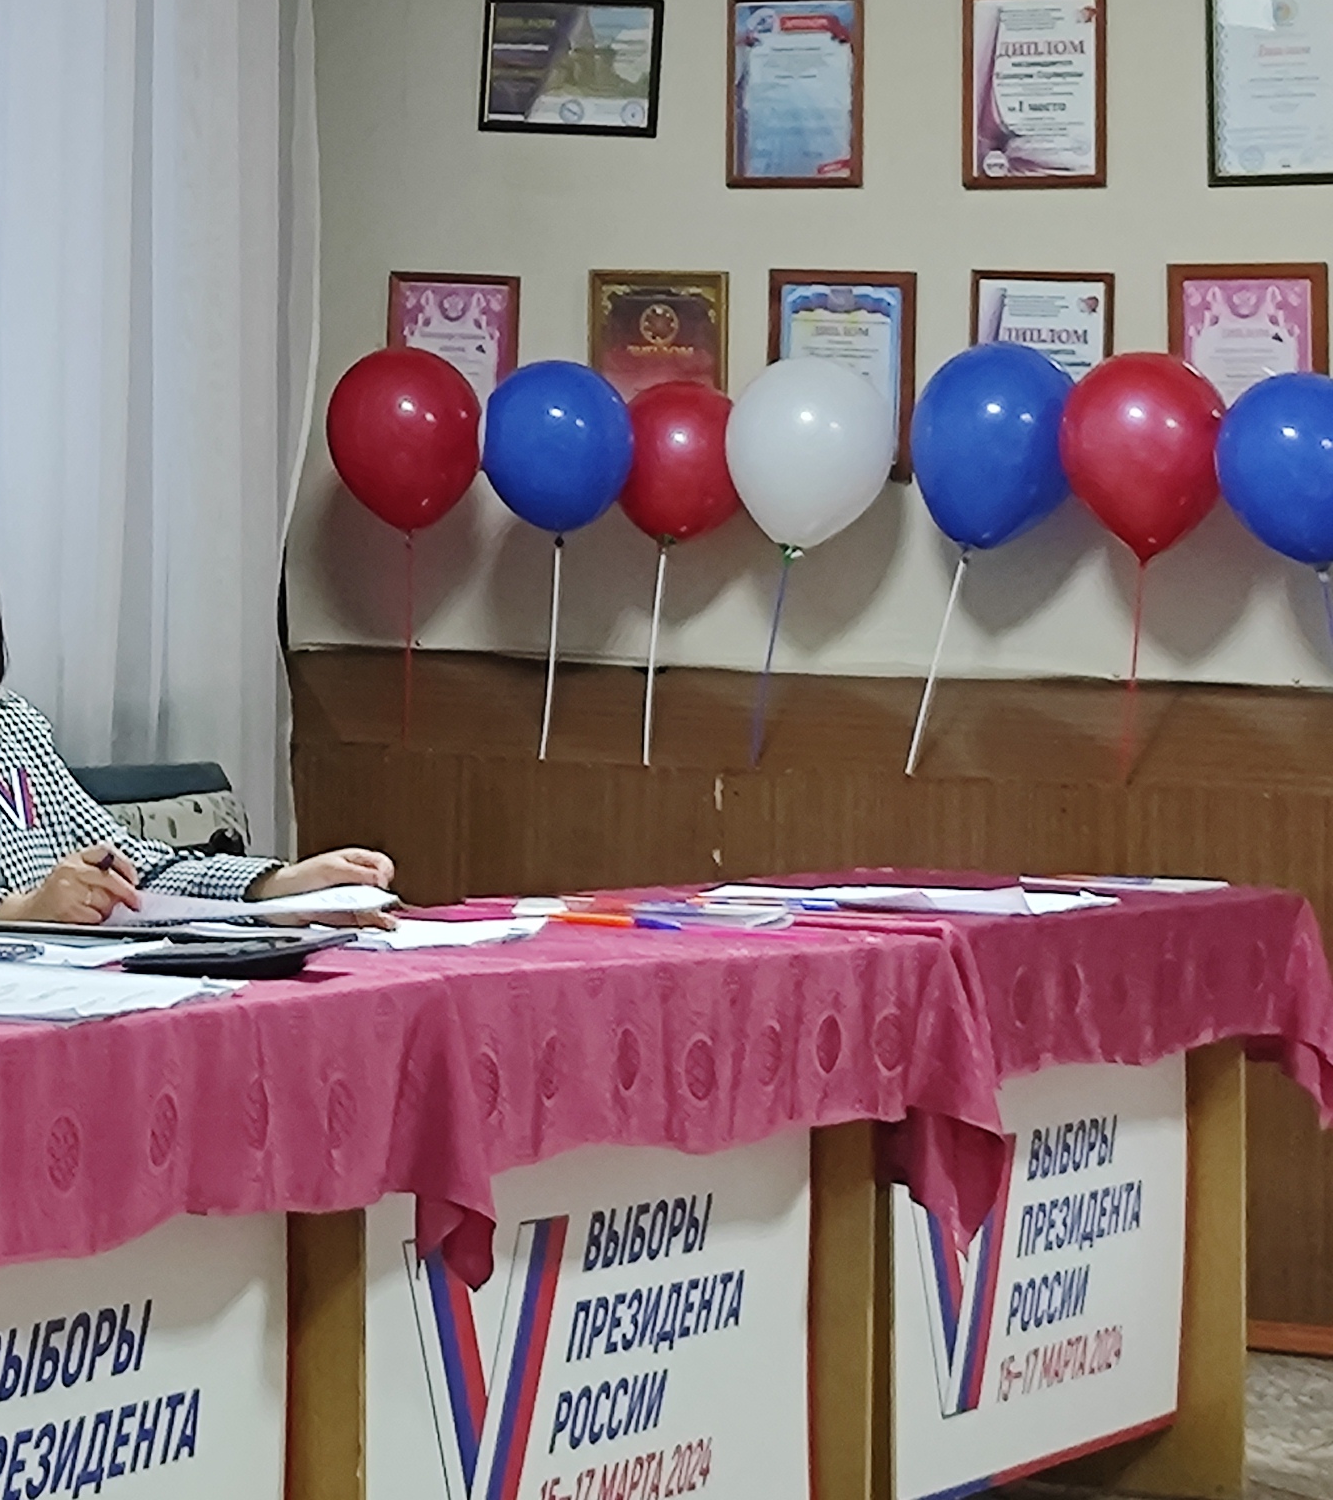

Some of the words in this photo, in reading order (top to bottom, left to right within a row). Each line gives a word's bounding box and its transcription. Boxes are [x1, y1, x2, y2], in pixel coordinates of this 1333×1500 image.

[996, 39, 1085, 58] ДИПЛОМ
[1027, 1114, 1117, 1181] ВЫБОРЫ
[582, 1192, 713, 1271] ВЫБОРЫ
[1016, 1178, 1142, 1258] ПРЕЗИДЕНТА
[565, 1269, 746, 1362] ПРЕЗИДЕНТА
[1005, 1263, 1090, 1336] РОССИИ
[547, 1368, 668, 1454] РОССИИ
[596, 1450, 664, 1500] МАРТА
[663, 1436, 712, 1497] 2024
